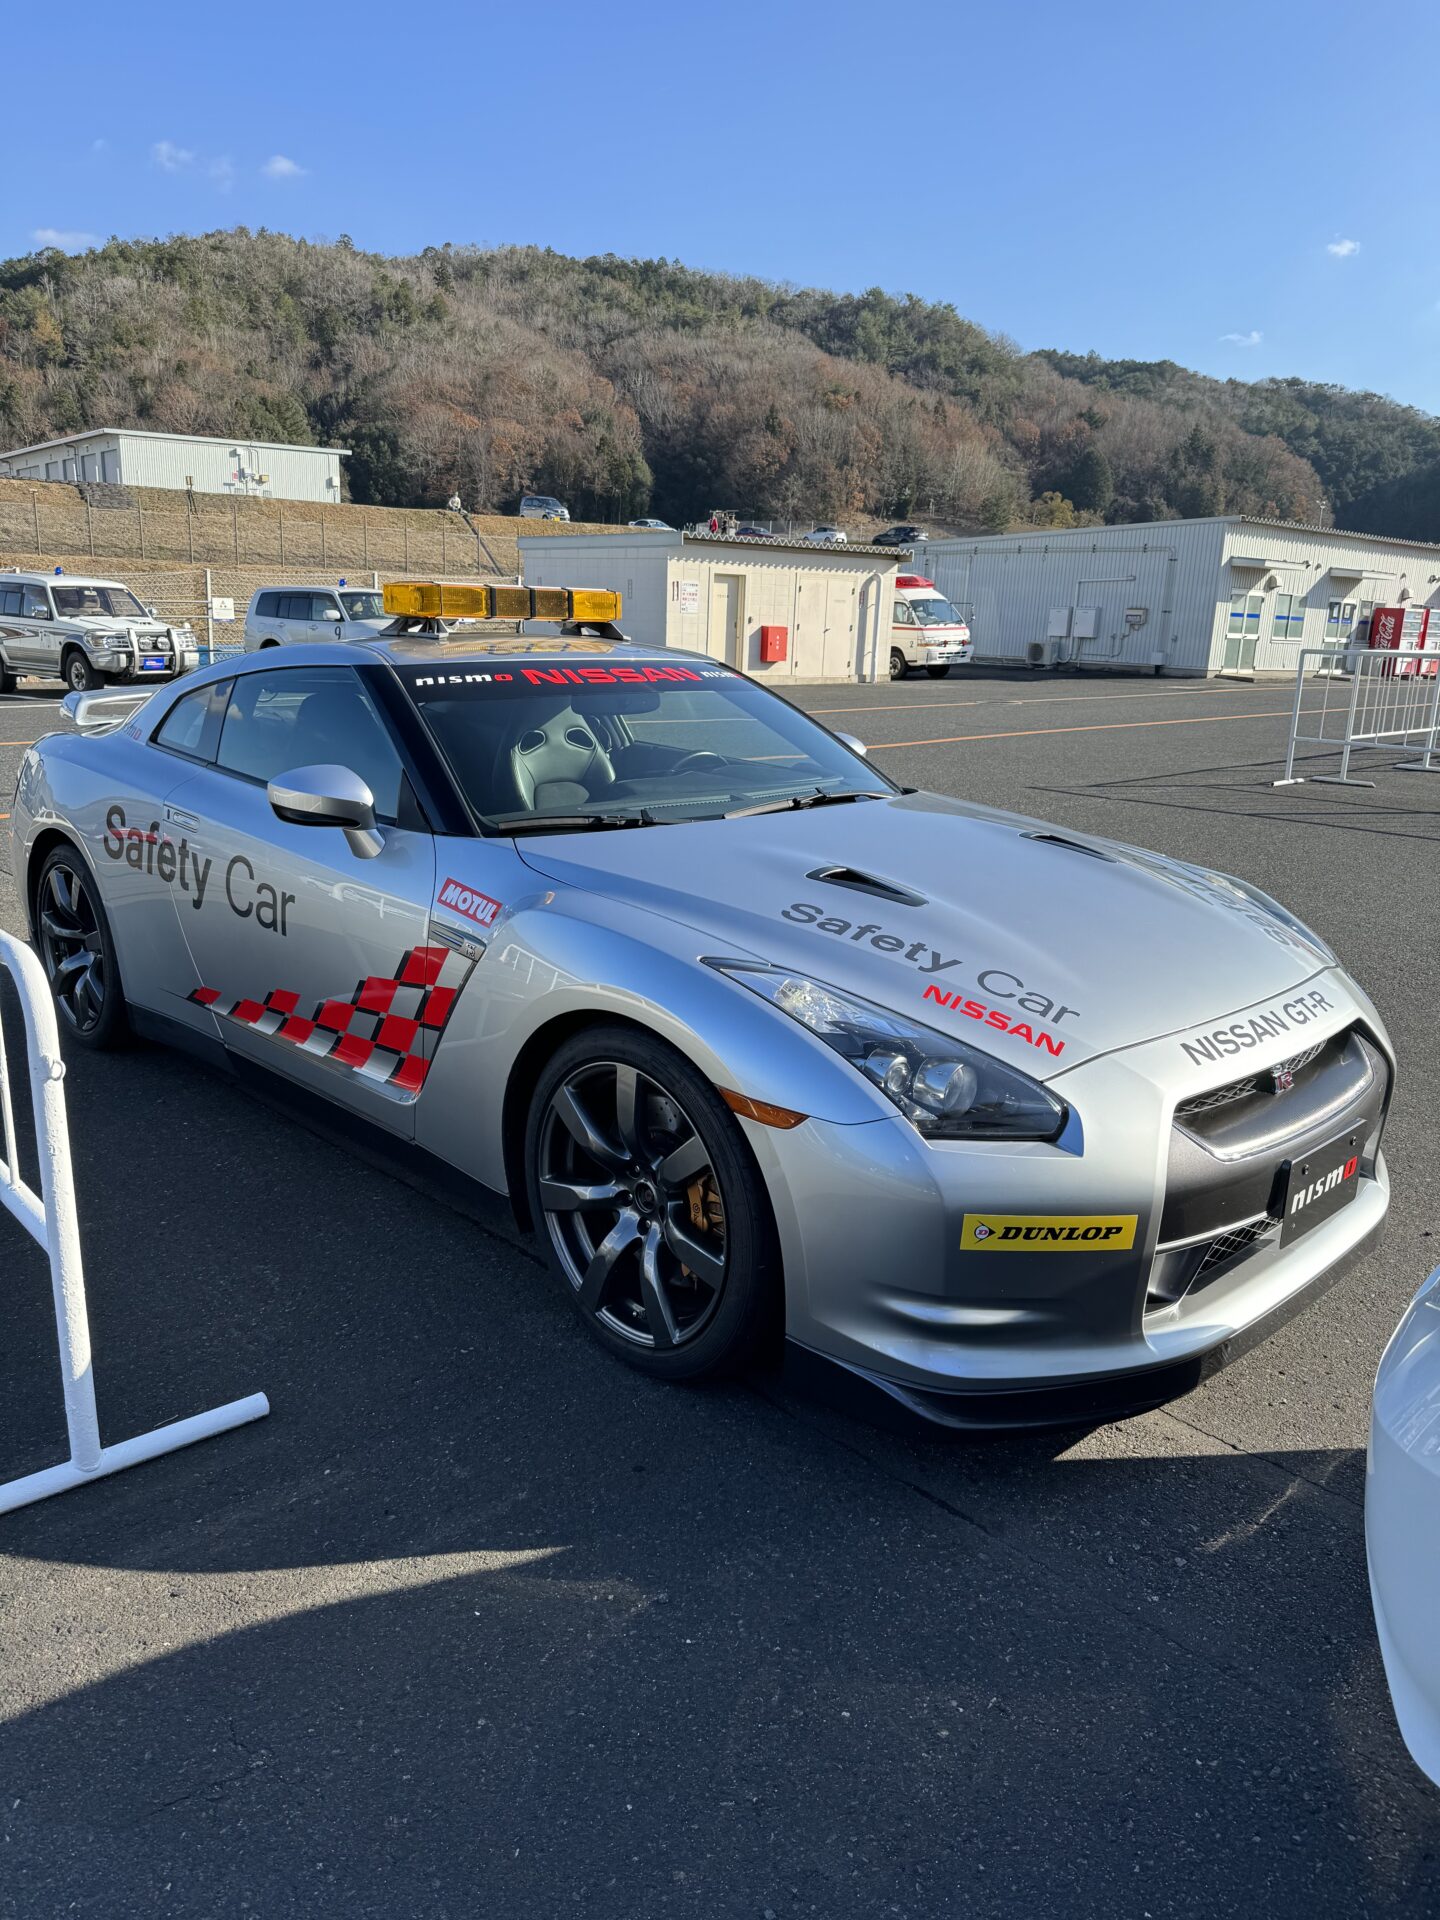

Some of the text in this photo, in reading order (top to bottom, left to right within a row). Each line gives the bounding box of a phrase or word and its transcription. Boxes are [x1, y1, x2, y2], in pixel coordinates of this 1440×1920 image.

[334, 625, 342, 640] 9
[415, 673, 513, 687] nismo
[520, 667, 703, 685] NISSAN
[103, 804, 296, 937] Safety Car
[440, 883, 498, 924] MOTUL
[780, 902, 1081, 1025] Safety Car
[922, 984, 1066, 1057] NISSAN
[1179, 990, 1335, 1066] NISSAN GT-R
[1290, 1155, 1358, 1215] nismo
[997, 1226, 1123, 1241] DUNLOP
